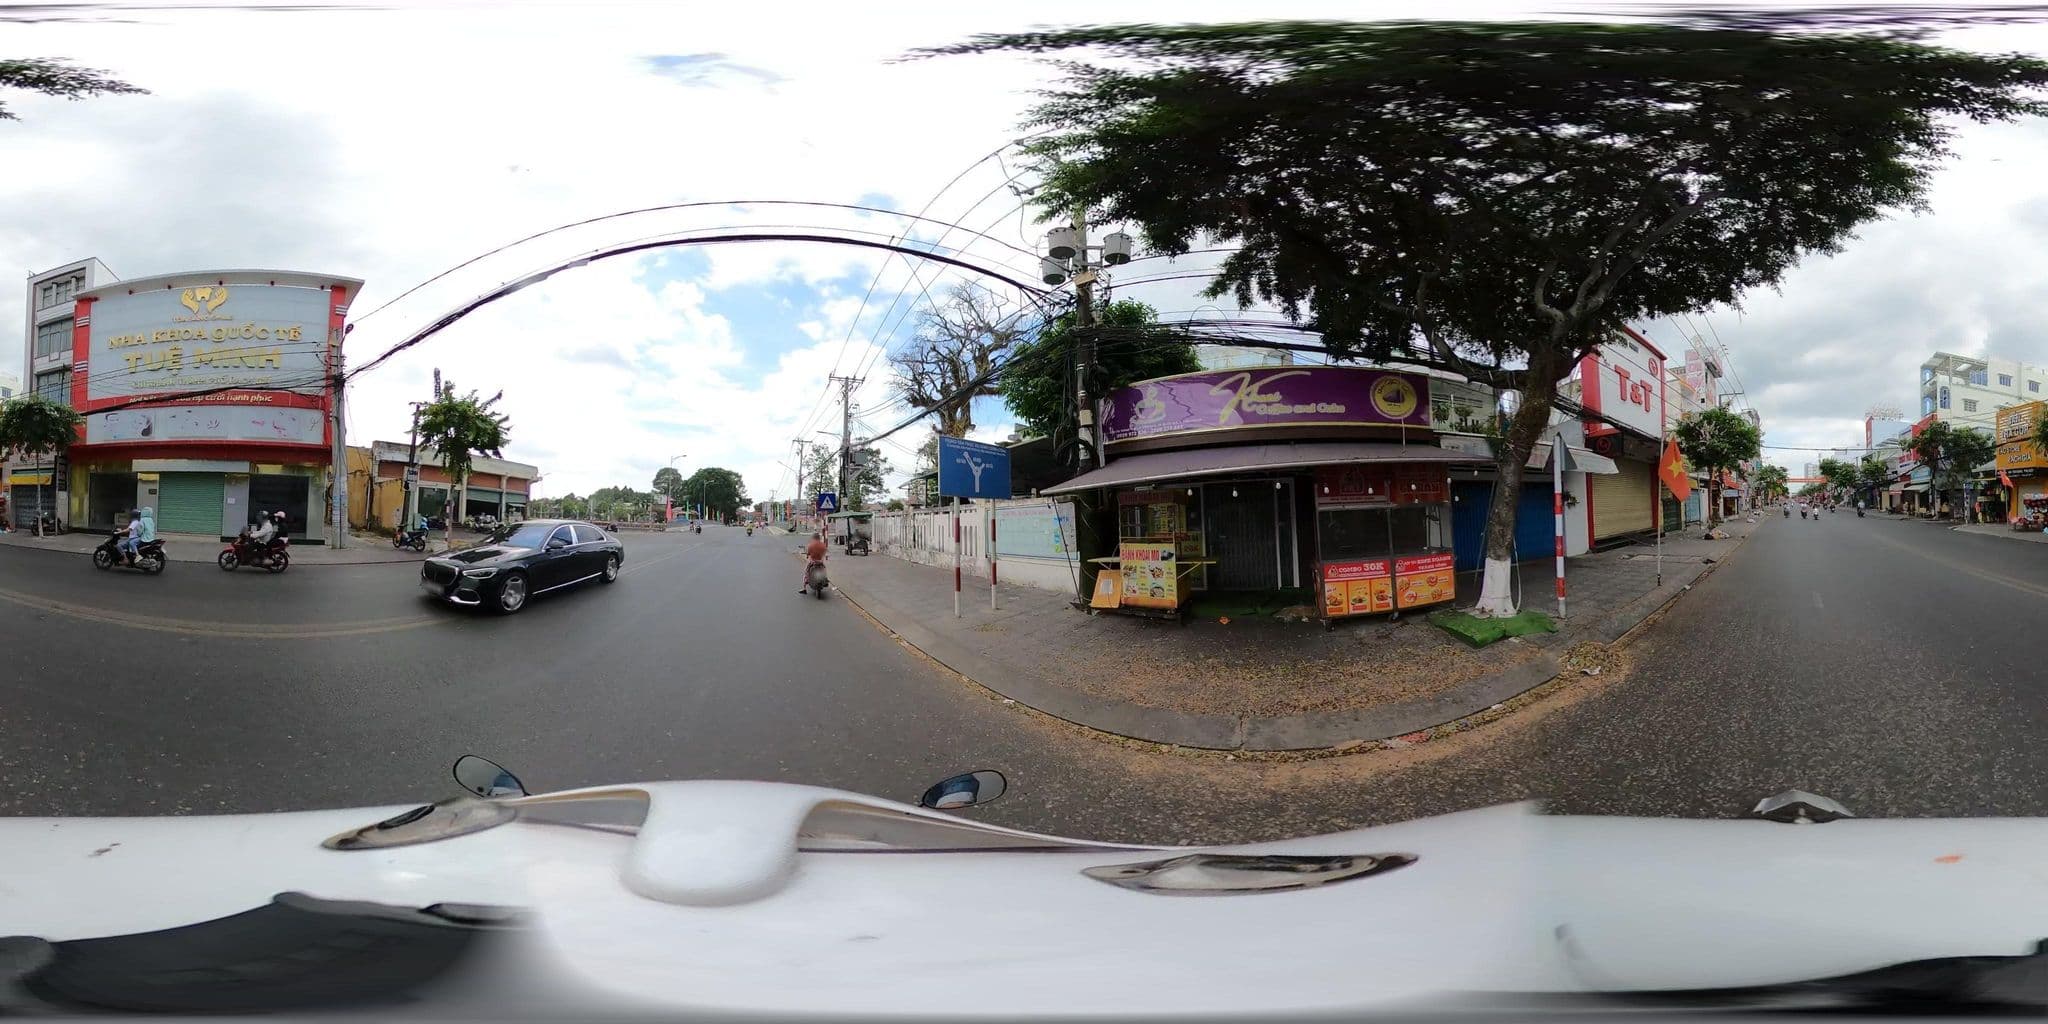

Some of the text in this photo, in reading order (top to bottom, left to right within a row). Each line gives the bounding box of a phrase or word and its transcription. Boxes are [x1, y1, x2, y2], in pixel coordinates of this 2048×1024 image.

[108, 320, 302, 349] NHA KHOA QUỐC TẾ
[123, 345, 281, 375] TUỆ MINH
[226, 393, 249, 402] hạnh
[1614, 364, 1653, 413] T&T
[1293, 404, 1316, 413] and
[1362, 562, 1385, 572] 30K
